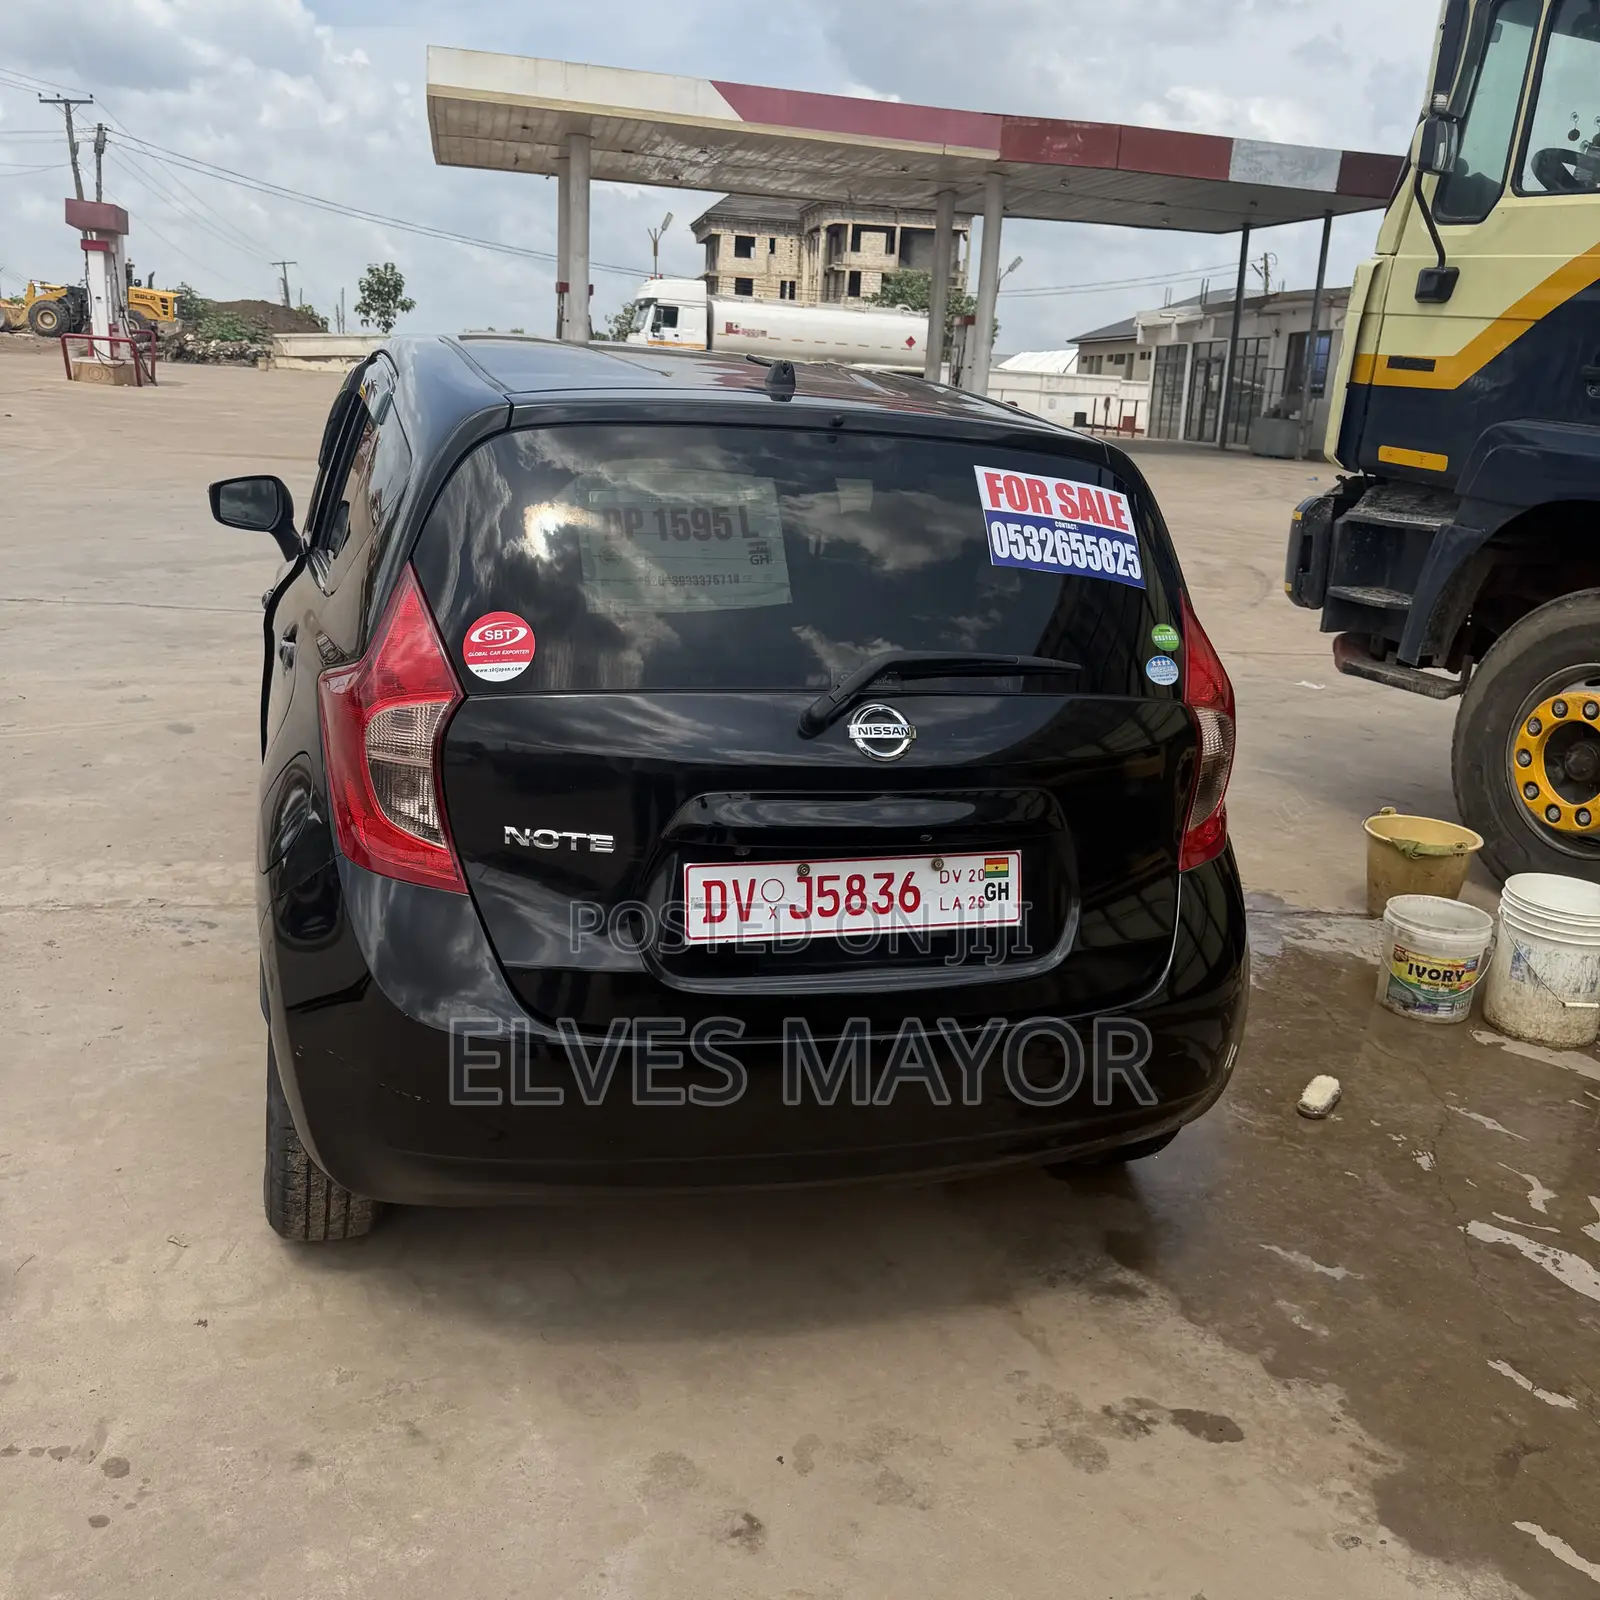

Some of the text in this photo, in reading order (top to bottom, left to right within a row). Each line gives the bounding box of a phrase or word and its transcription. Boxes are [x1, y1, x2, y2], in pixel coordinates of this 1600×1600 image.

[984, 472, 1129, 531] FOR SALE
[653, 506, 733, 541] 1595
[738, 505, 759, 539] L
[1055, 521, 1079, 531] CONTACT:
[749, 553, 770, 565] GH
[990, 521, 1142, 580] 0532655825
[485, 629, 513, 641] SBT
[858, 726, 910, 736] NISSAN
[504, 825, 614, 854] NOTE
[940, 868, 985, 884] DV 20
[702, 878, 757, 924] DV
[789, 871, 921, 920] J5836
[984, 882, 1009, 902] GH
[940, 895, 985, 911] LA 26
[1408, 963, 1465, 982] IVORY
